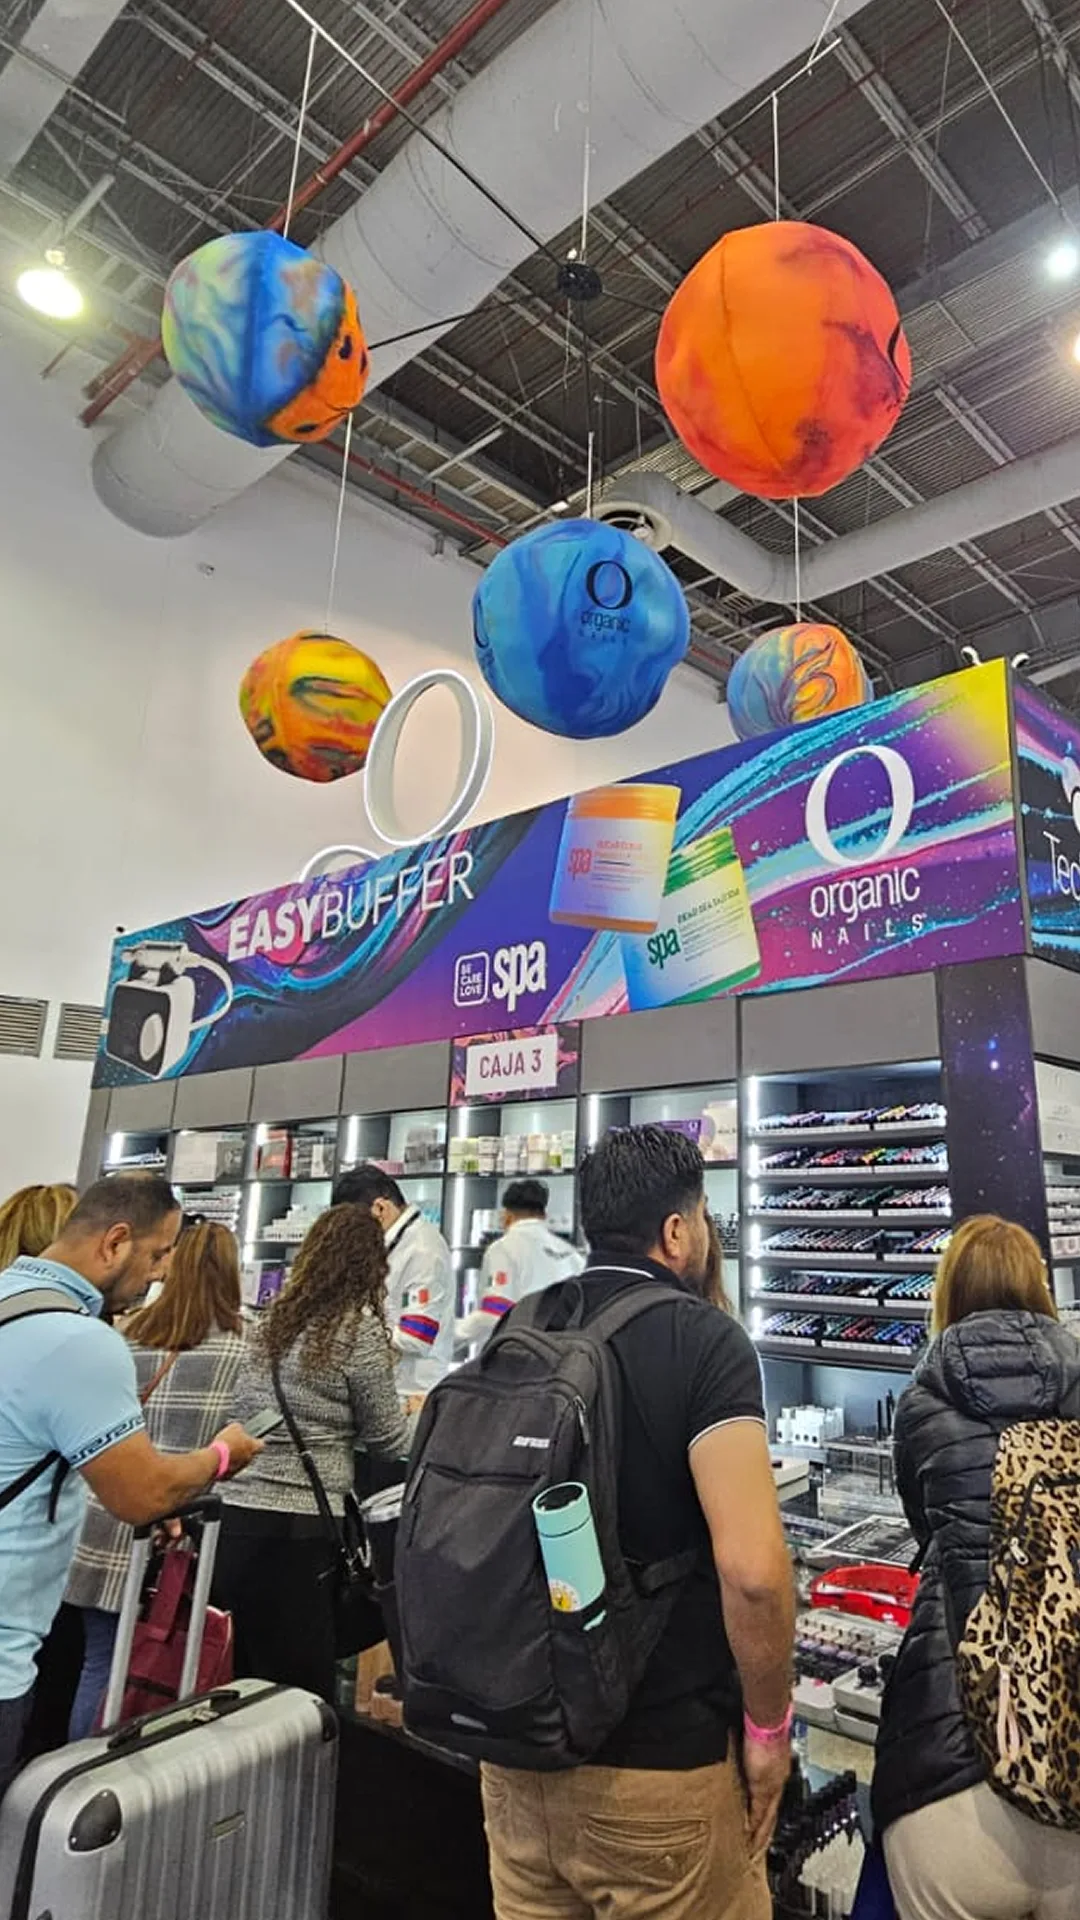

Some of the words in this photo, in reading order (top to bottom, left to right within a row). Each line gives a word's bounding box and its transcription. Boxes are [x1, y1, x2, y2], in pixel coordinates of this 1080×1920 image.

[805, 745, 915, 867] O
[810, 866, 920, 922] organic
[647, 928, 681, 969] spa
[811, 913, 926, 949] NAILS
[492, 940, 547, 1012] spa
[479, 1051, 525, 1079] CAJA
[531, 1048, 542, 1073] 3
